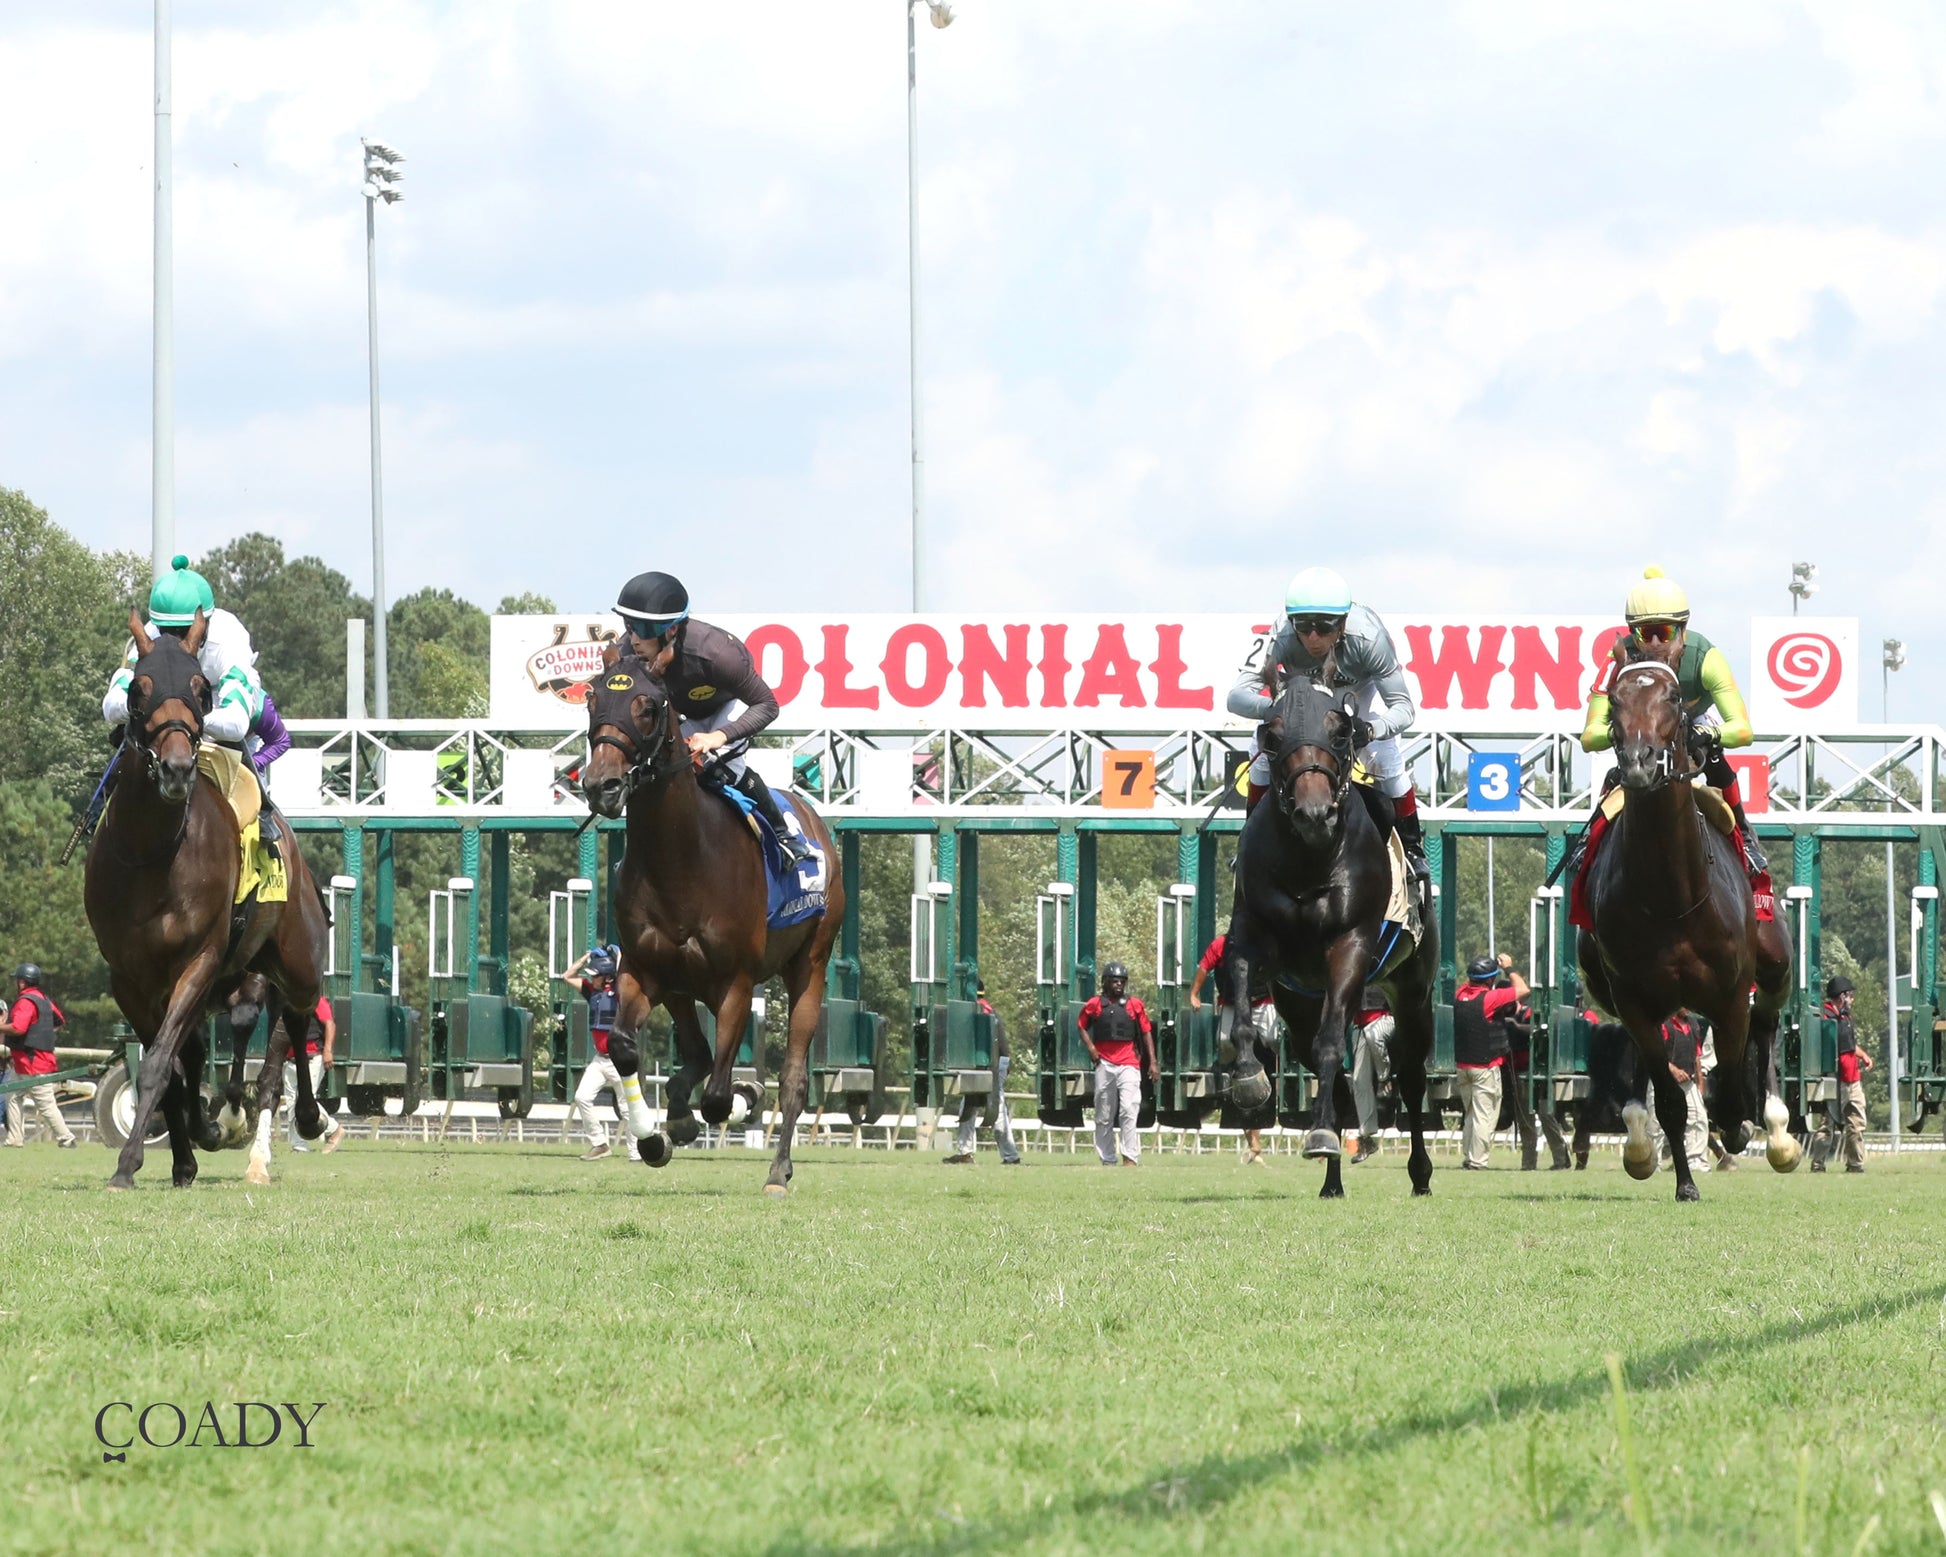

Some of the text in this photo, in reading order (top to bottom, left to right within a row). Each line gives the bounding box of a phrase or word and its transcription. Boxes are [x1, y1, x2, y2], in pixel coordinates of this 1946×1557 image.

[534, 645, 605, 670] COLONIA
[553, 660, 603, 675] DOWNS
[744, 623, 1215, 712] OLONIAL
[1245, 638, 1264, 667] 2
[1115, 762, 1142, 796] 7
[1480, 763, 1509, 801] 3
[1736, 766, 1750, 802] 1
